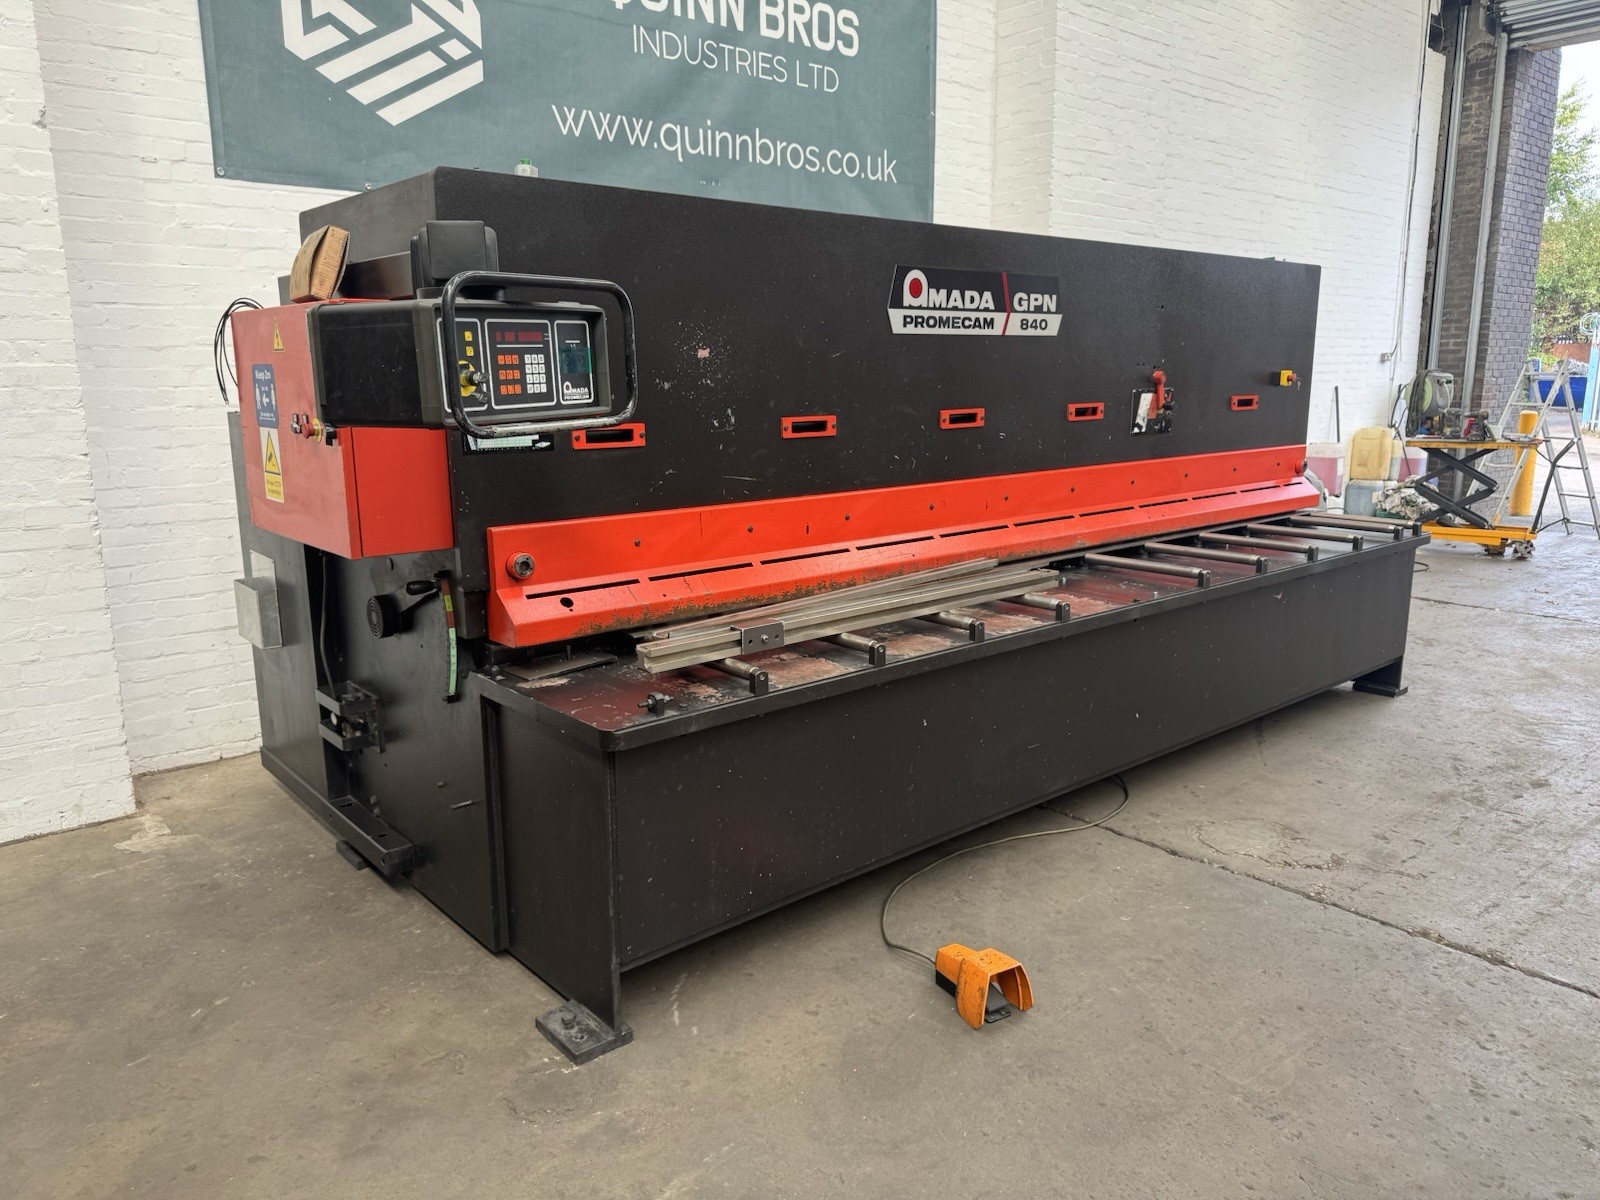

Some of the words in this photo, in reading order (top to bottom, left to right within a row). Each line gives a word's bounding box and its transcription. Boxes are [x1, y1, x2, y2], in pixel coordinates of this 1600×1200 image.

[759, 0, 860, 58] BROS
[632, 24, 788, 83] INDUSTRIES
[795, 60, 839, 93] LTD
[551, 104, 898, 184] www.quinnbros.co.uk
[902, 314, 996, 330] PROMECAM
[1019, 318, 1049, 331] 840
[1012, 292, 1058, 313] GPN
